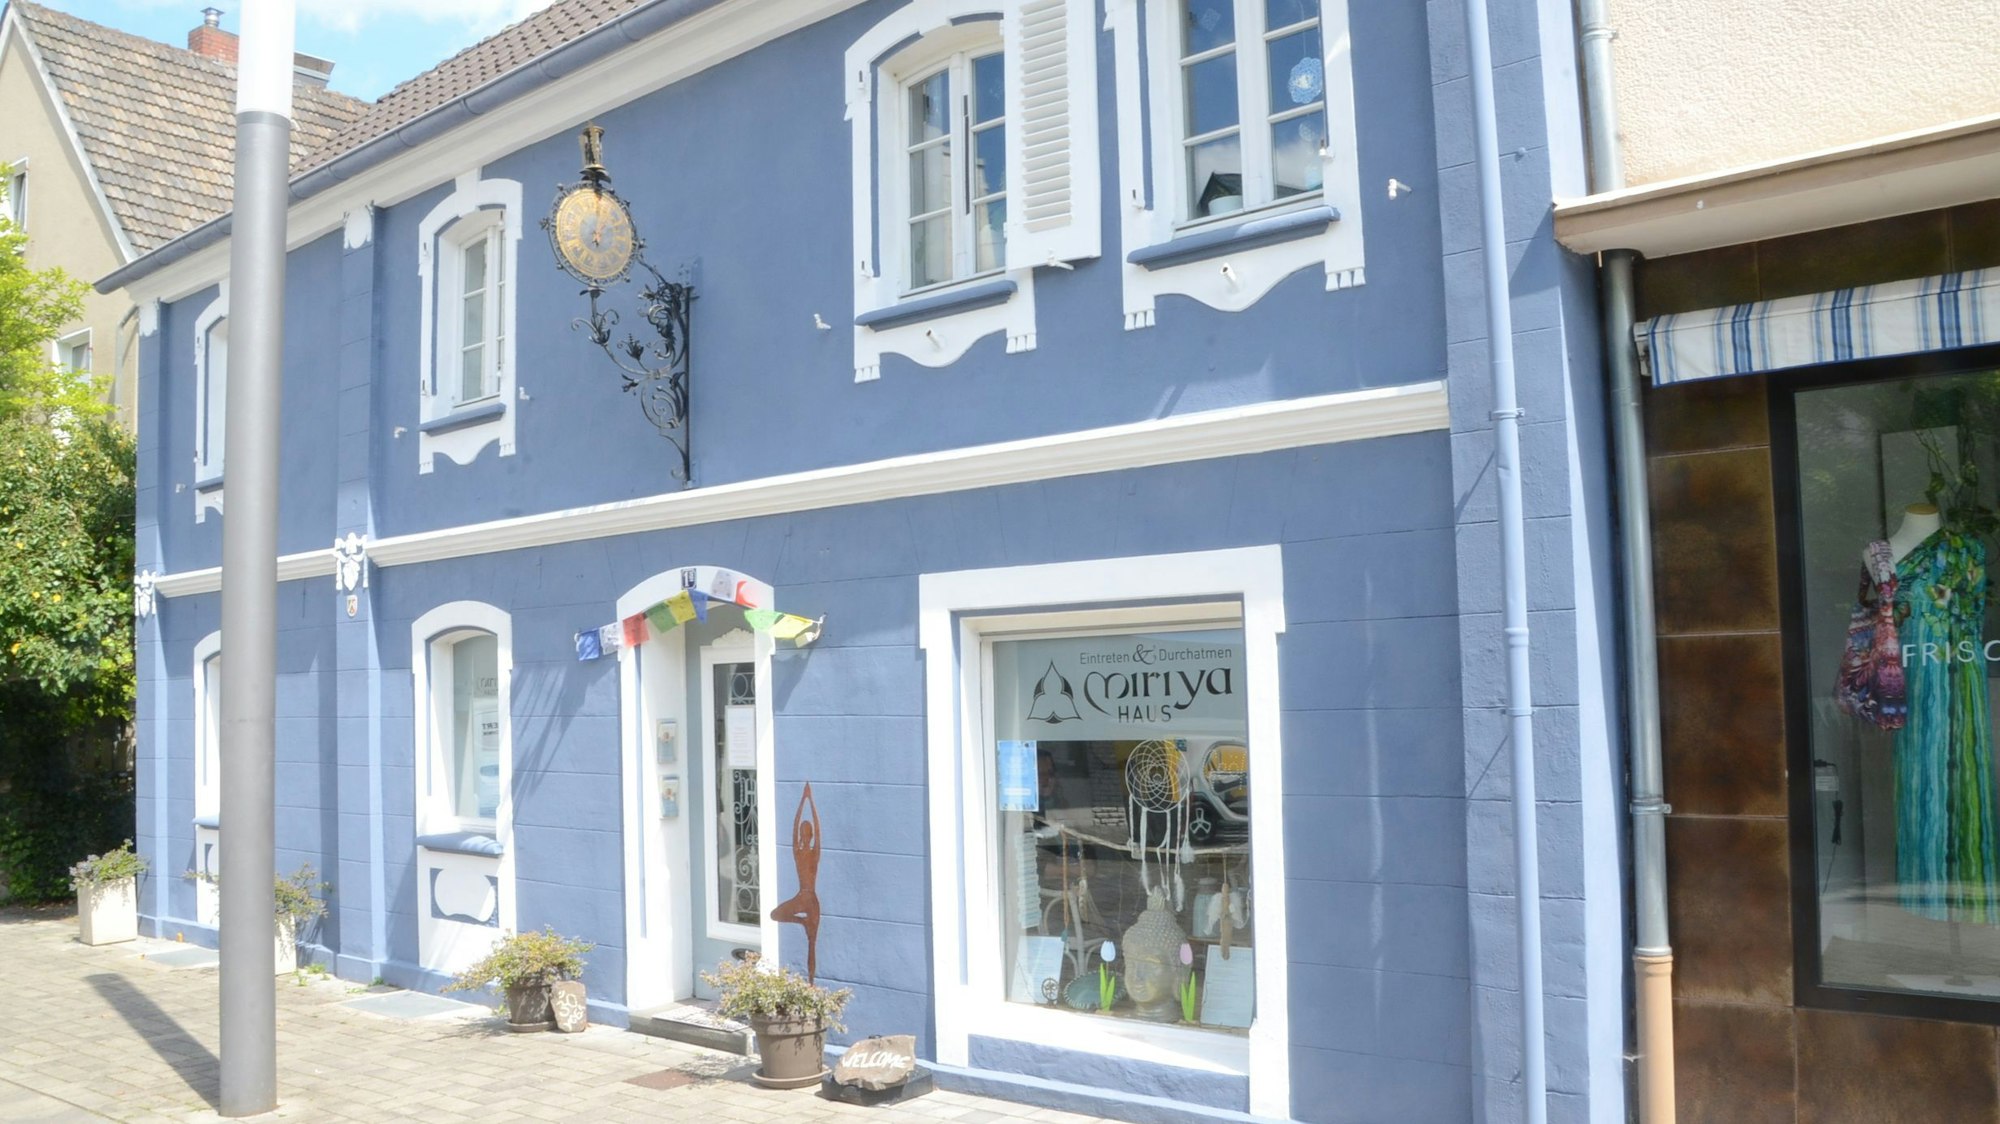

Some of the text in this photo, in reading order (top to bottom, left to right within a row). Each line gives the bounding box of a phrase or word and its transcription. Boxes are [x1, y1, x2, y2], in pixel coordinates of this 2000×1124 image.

[1080, 644, 1232, 665] Eintreten & Durchatmen
[1118, 704, 1172, 723] HAUS
[841, 1051, 911, 1068] WELCOME
